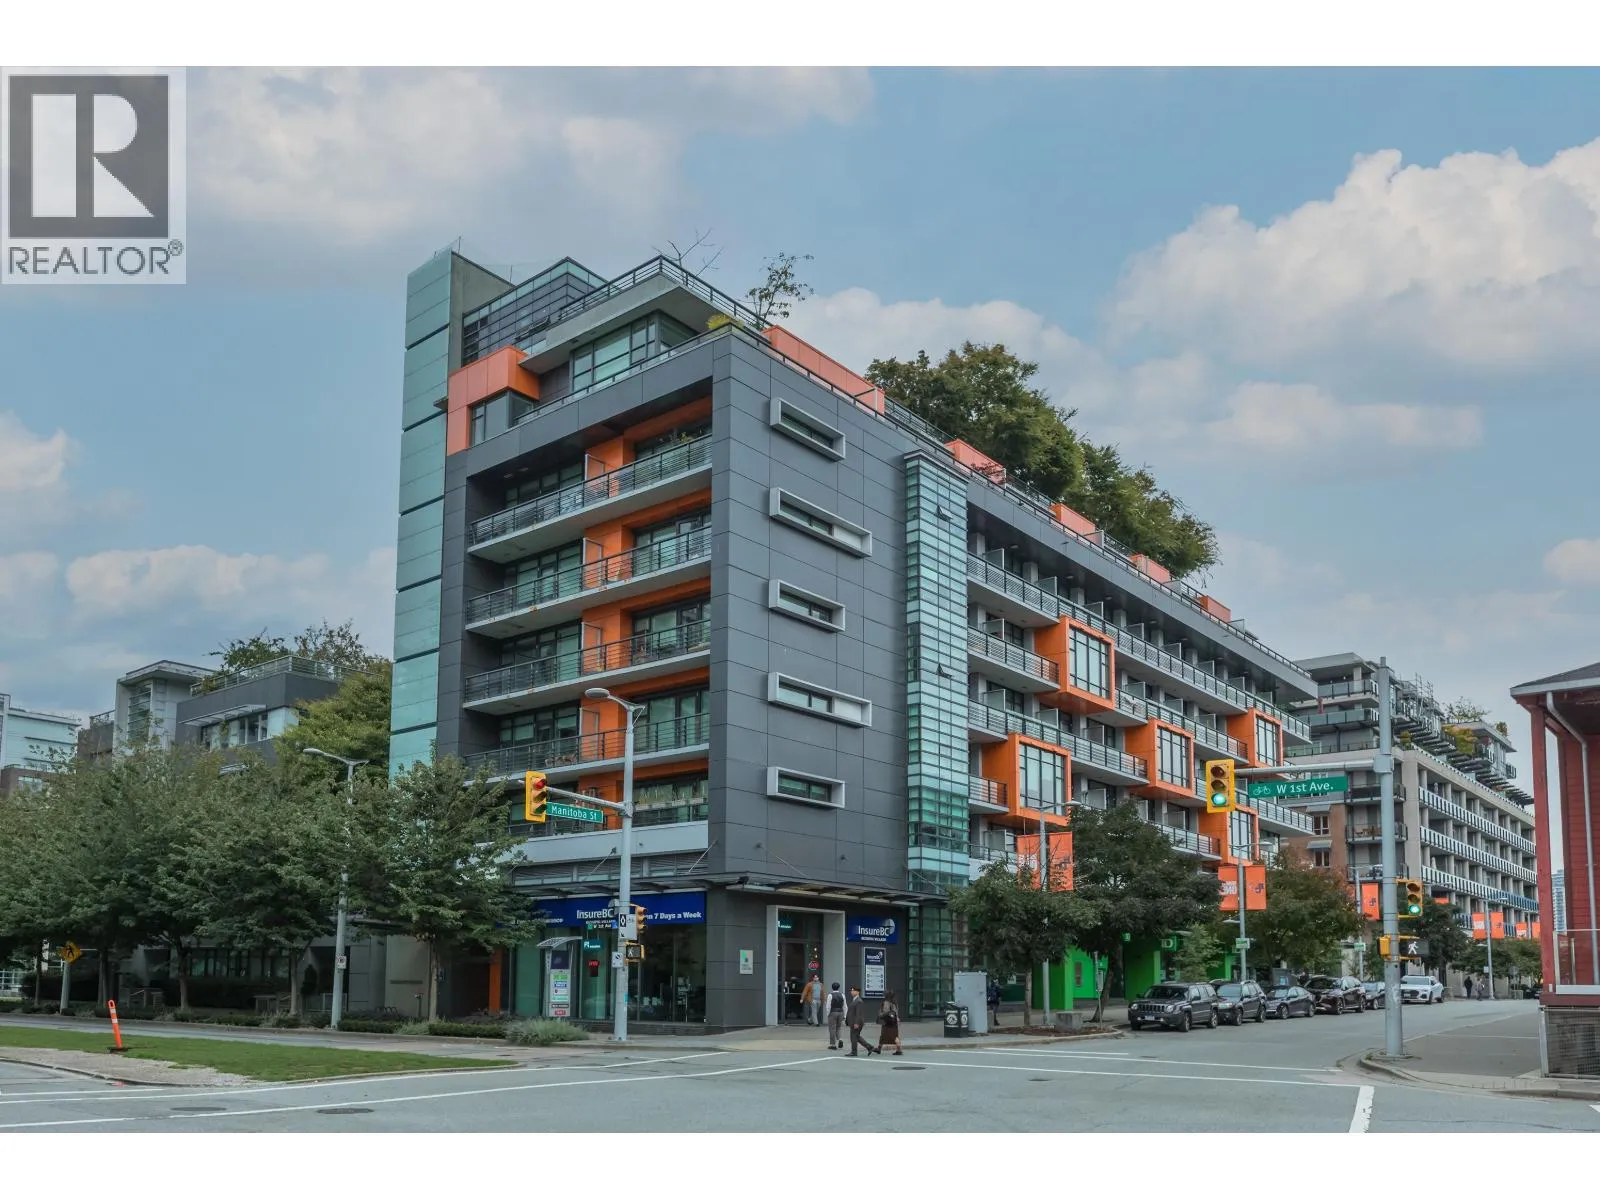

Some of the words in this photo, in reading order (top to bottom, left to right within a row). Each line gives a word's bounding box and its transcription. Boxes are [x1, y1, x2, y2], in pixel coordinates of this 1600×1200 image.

[1276, 784, 1287, 794] W
[1290, 784, 1307, 793] 1st
[1309, 782, 1334, 792] Ave.
[551, 805, 587, 819] Manitoba
[590, 811, 597, 820] St
[576, 908, 614, 919] InsureBC
[653, 912, 659, 920] 7
[659, 912, 676, 921] Days
[682, 911, 702, 919] Week
[858, 925, 889, 936] InsureBC
